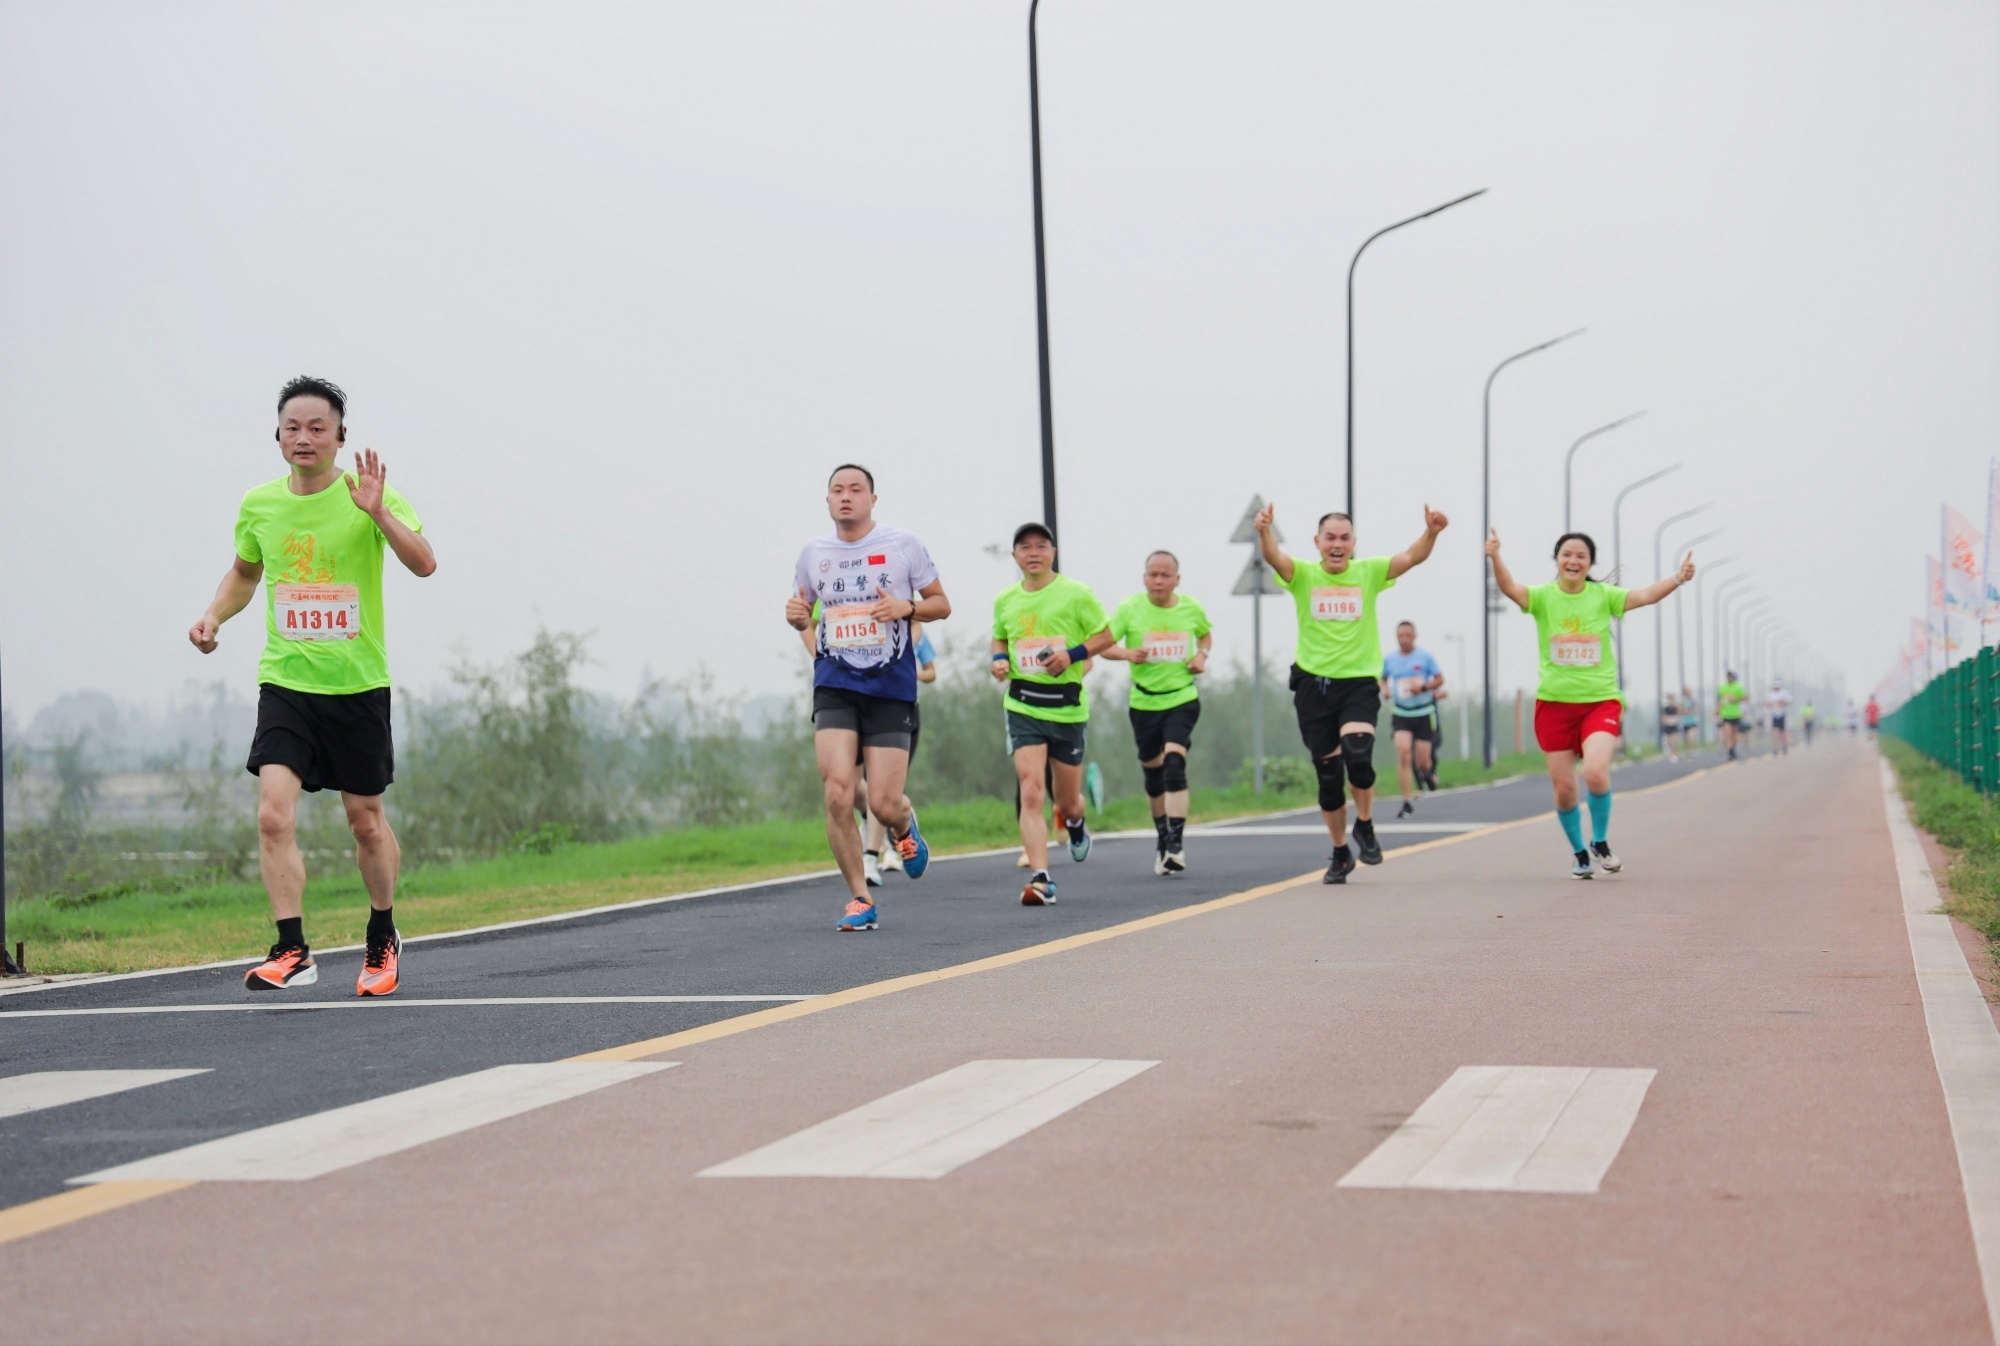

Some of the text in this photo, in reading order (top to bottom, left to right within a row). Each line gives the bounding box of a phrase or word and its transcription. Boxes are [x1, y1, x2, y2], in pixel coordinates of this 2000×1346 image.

[817, 573, 892, 593] 中国警察
[1318, 602, 1356, 613] A1196
[286, 609, 348, 630] A1314
[836, 621, 878, 639] A1154
[857, 647, 883, 656] POLICE
